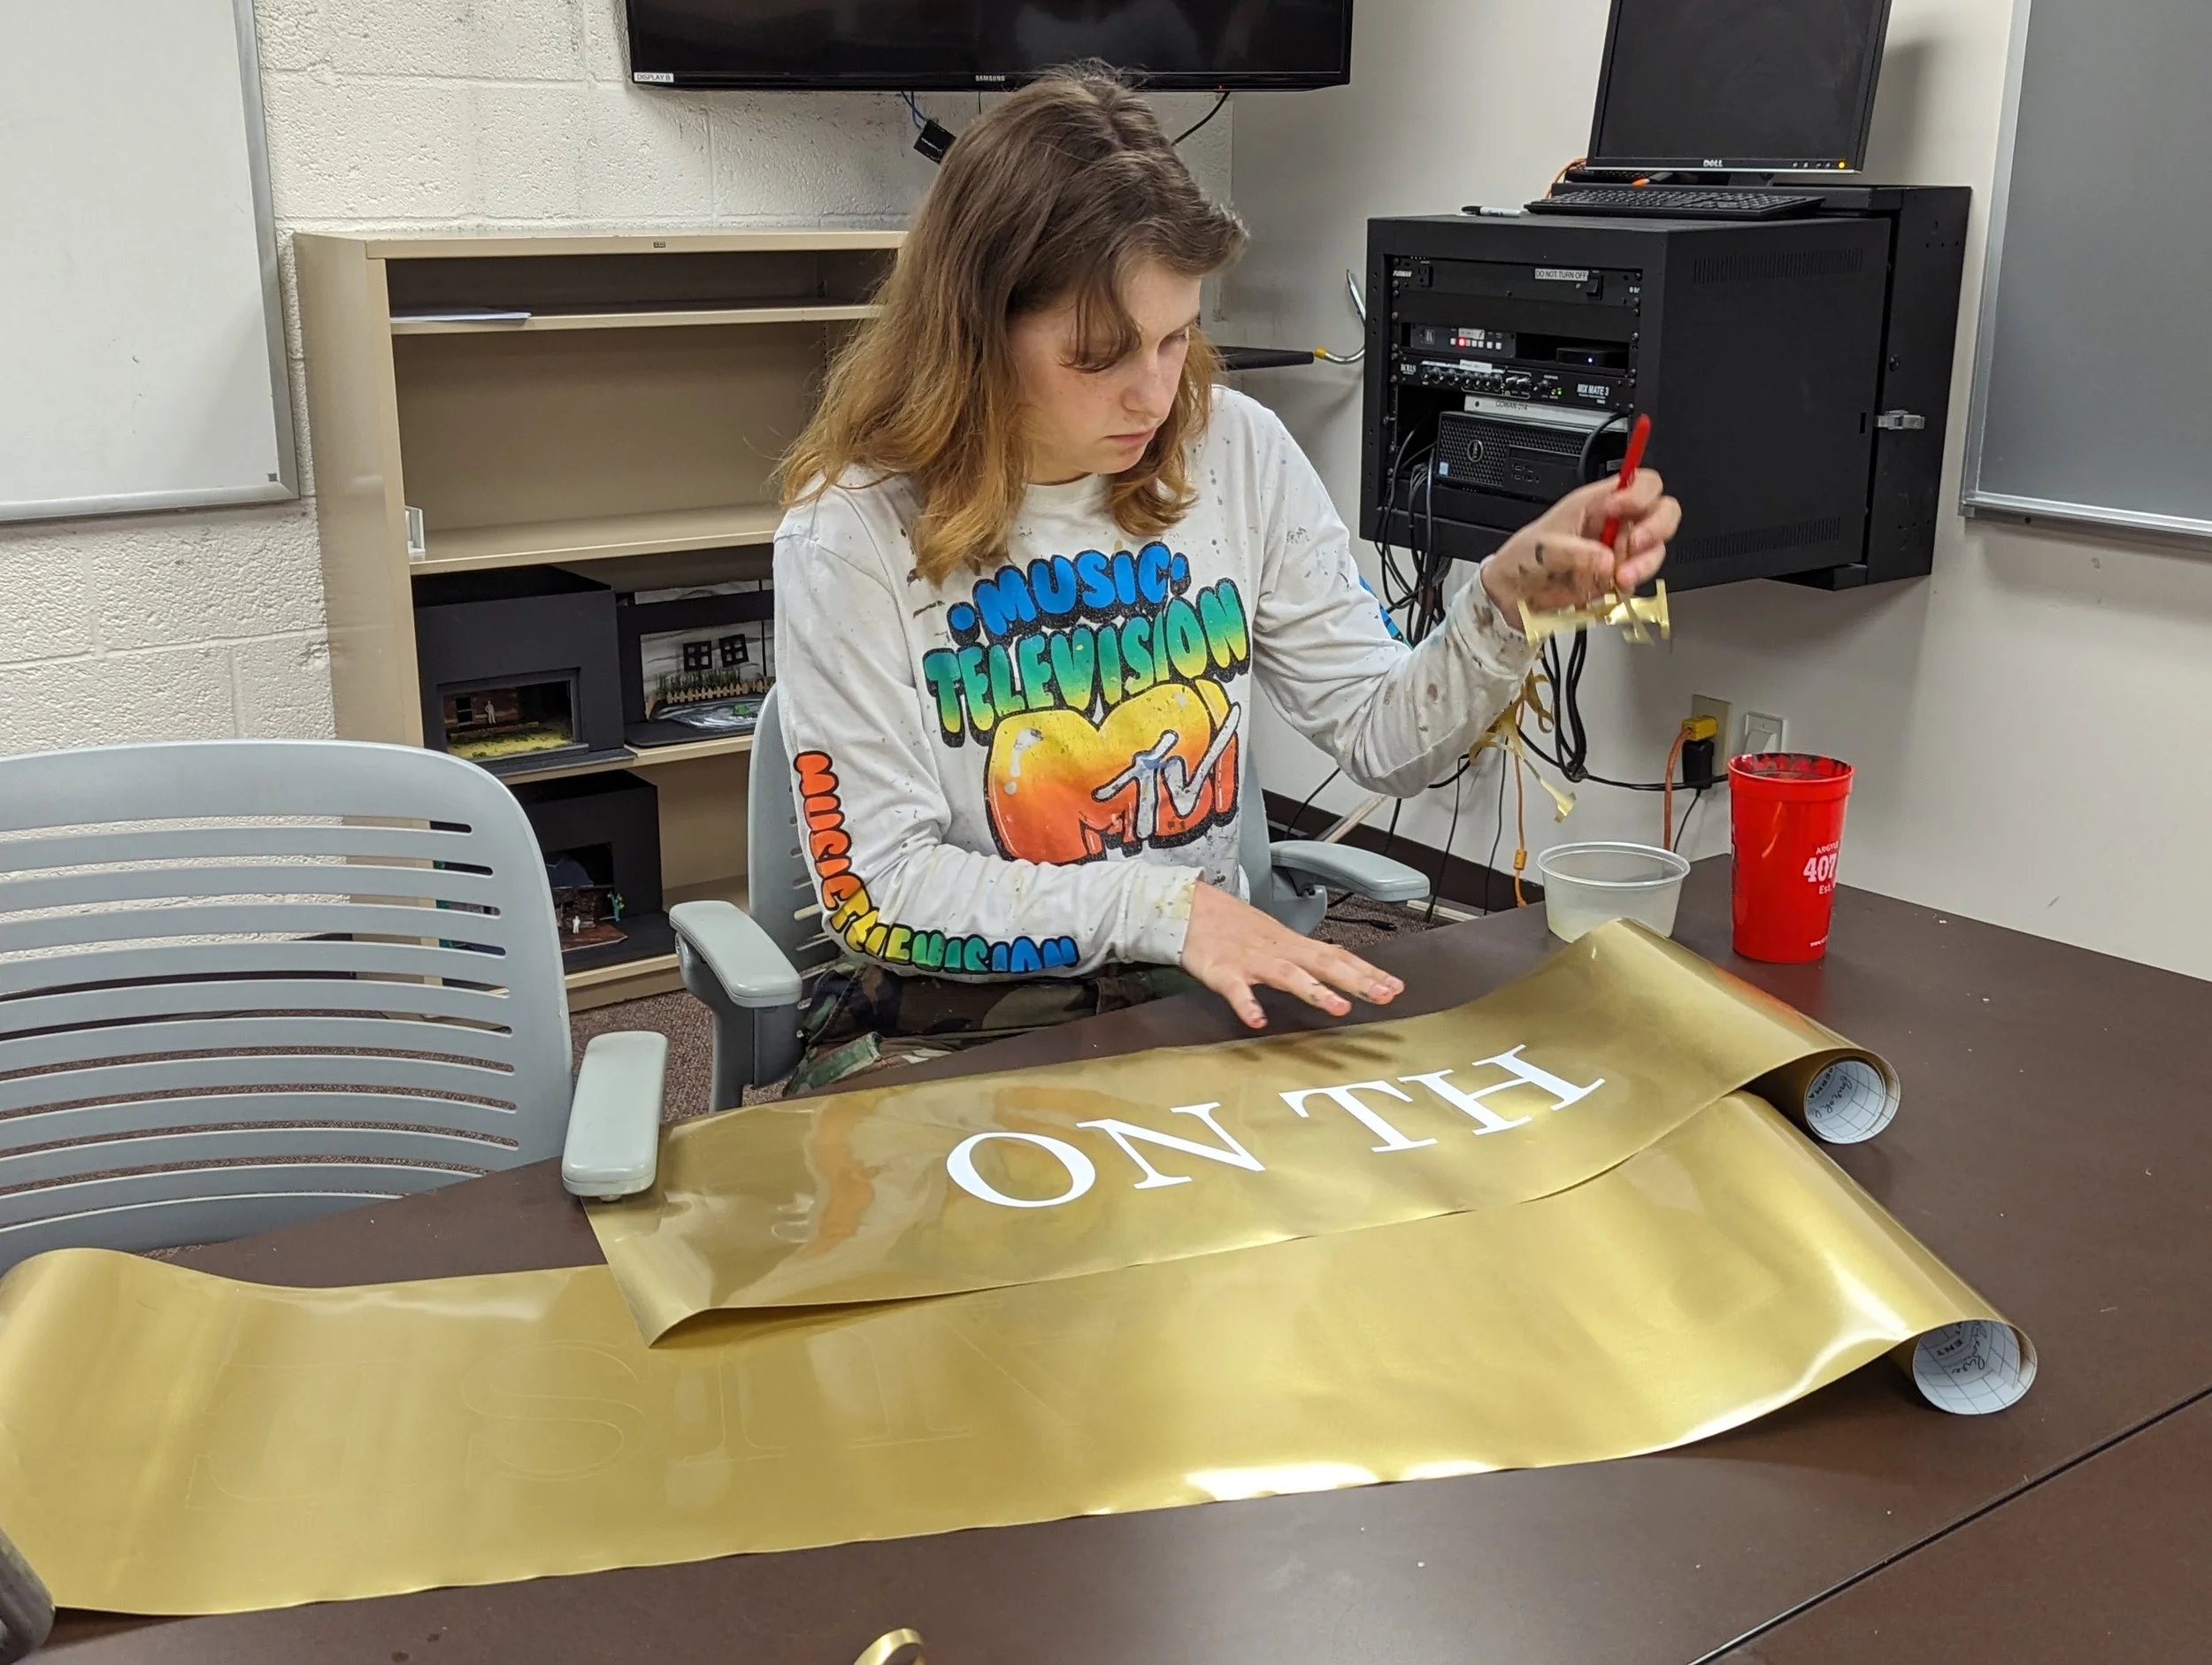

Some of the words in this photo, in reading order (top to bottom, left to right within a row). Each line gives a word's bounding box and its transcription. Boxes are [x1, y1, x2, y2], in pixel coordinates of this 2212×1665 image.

[1558, 271, 1574, 280] TURN
[1575, 272, 1587, 280] OFF
[1577, 383, 1587, 394] MIX
[1588, 385, 1604, 395] MATE
[922, 578, 1250, 748] TELEVISION
[1803, 853, 1837, 883] 407
[946, 1101, 1265, 1208] ON
[1279, 1043, 1606, 1153] TH
